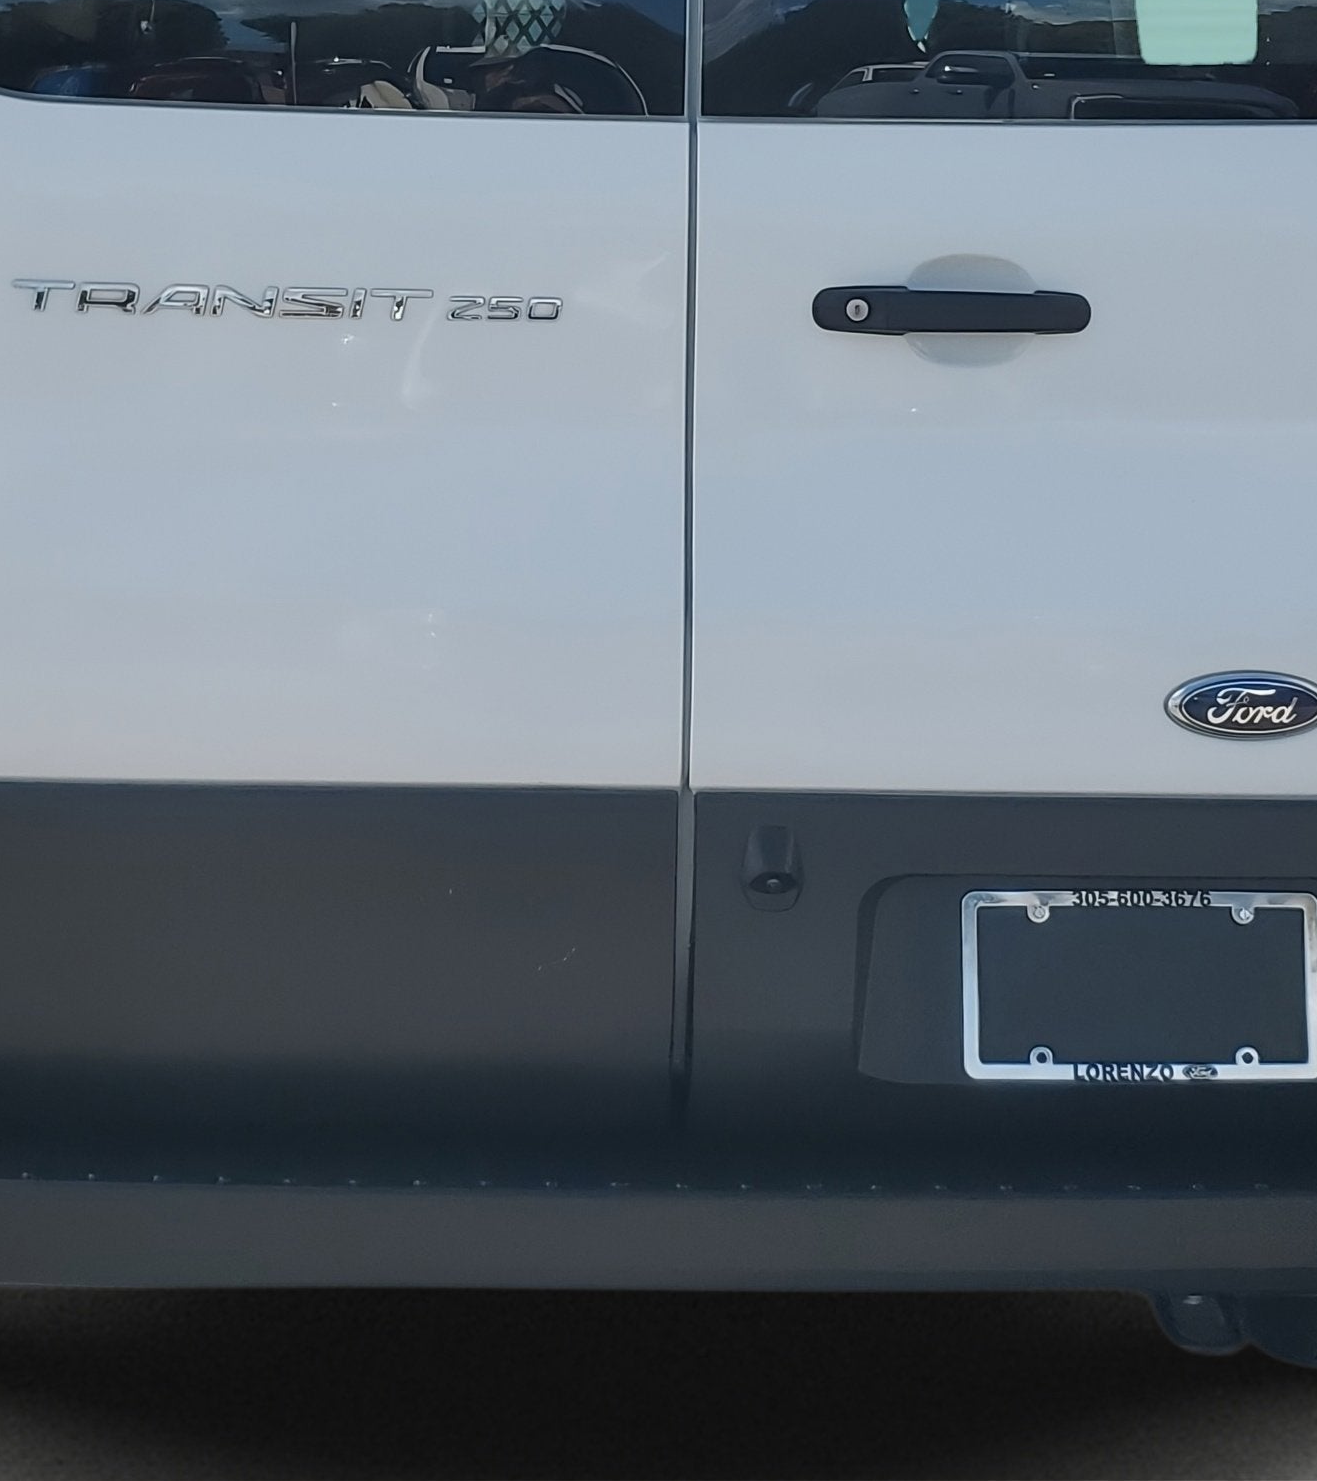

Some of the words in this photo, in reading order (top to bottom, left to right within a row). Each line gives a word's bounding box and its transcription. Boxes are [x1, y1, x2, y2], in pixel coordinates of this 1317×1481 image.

[10, 278, 435, 321] TRANSIT
[446, 294, 564, 321] 250
[1207, 687, 1298, 724] Ford
[1072, 890, 1212, 907] 305-600-3676
[1073, 1063, 1174, 1082] LORENZO
